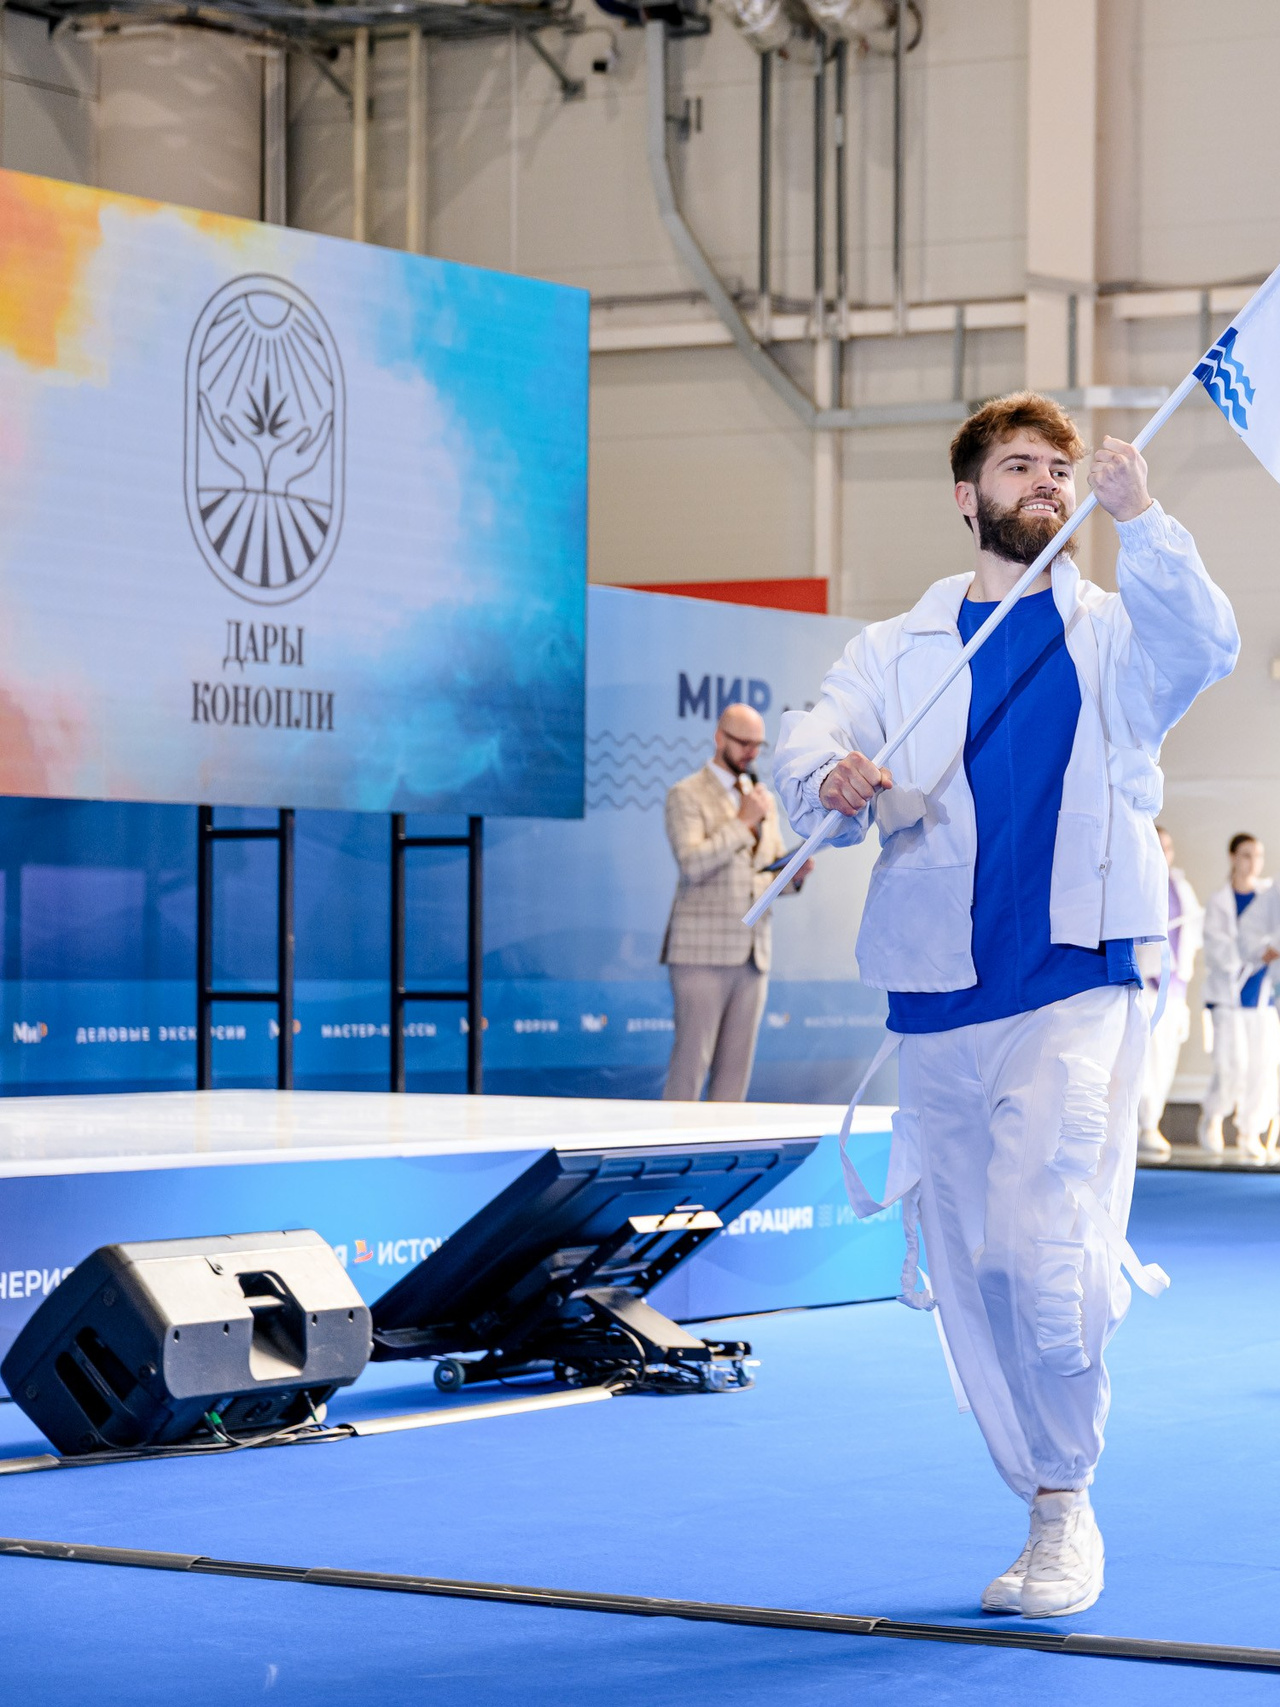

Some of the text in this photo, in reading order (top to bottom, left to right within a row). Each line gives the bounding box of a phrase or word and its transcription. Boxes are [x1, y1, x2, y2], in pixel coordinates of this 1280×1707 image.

[222, 619, 304, 672] ДАРЫ
[191, 680, 335, 731] КОНОПЛИ
[75, 1026, 150, 1044] ДЕЛОВЫЕ
[158, 1025, 246, 1042] ЭКСКСИИ
[321, 1023, 437, 1039] МАСТЕР-КССЫ
[721, 1206, 813, 1236] ЕГРАЦИЯ
[377, 1236, 449, 1266] ИСТО
